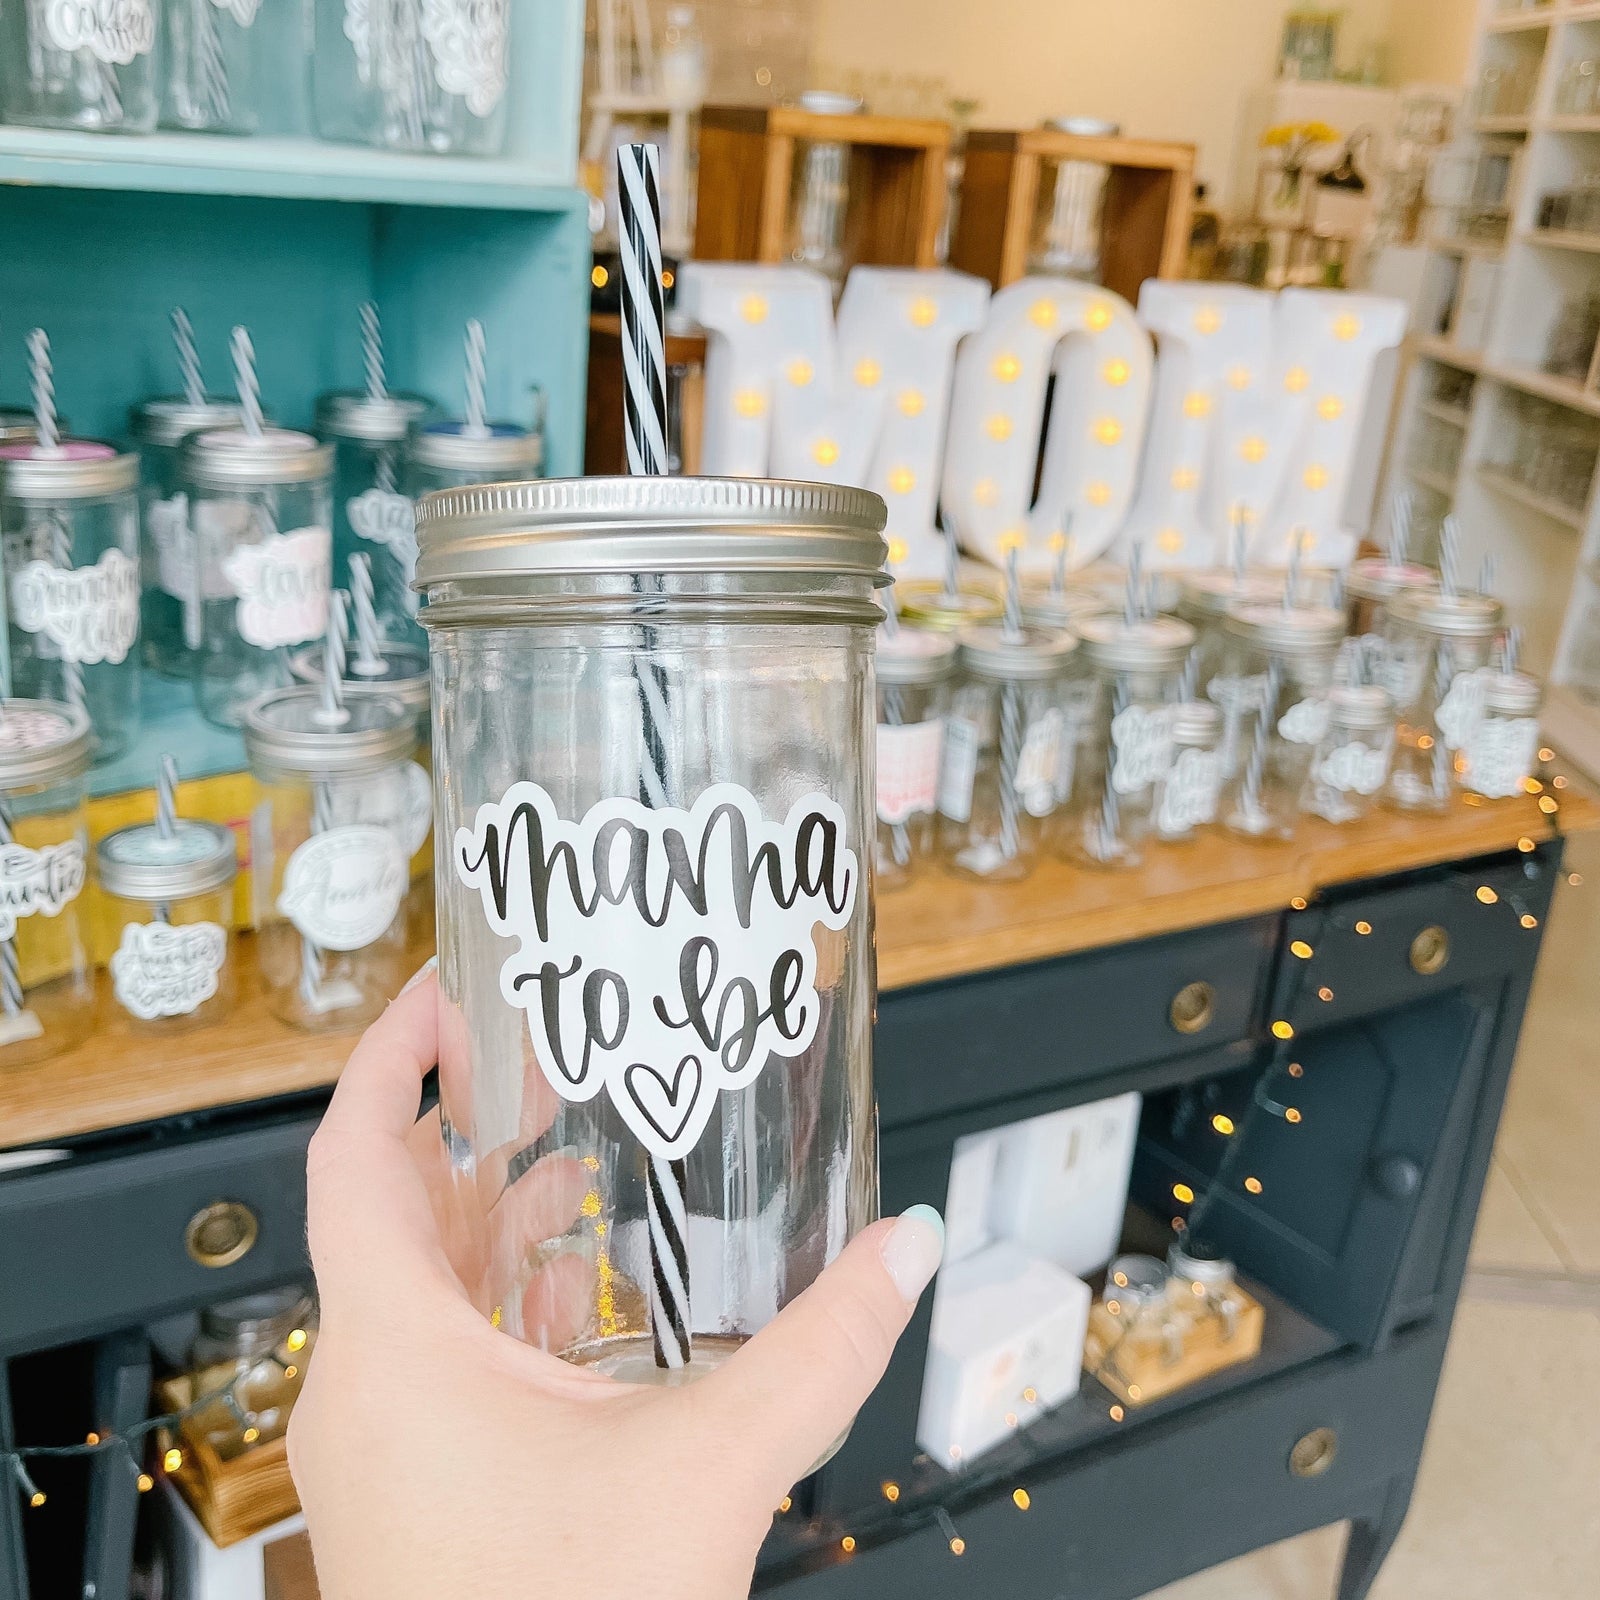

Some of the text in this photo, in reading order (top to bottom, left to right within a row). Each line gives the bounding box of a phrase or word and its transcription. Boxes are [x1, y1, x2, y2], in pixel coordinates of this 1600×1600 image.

[683, 263, 1406, 580] MOM
[462, 802, 850, 943] mama
[513, 936, 807, 1085] to be
